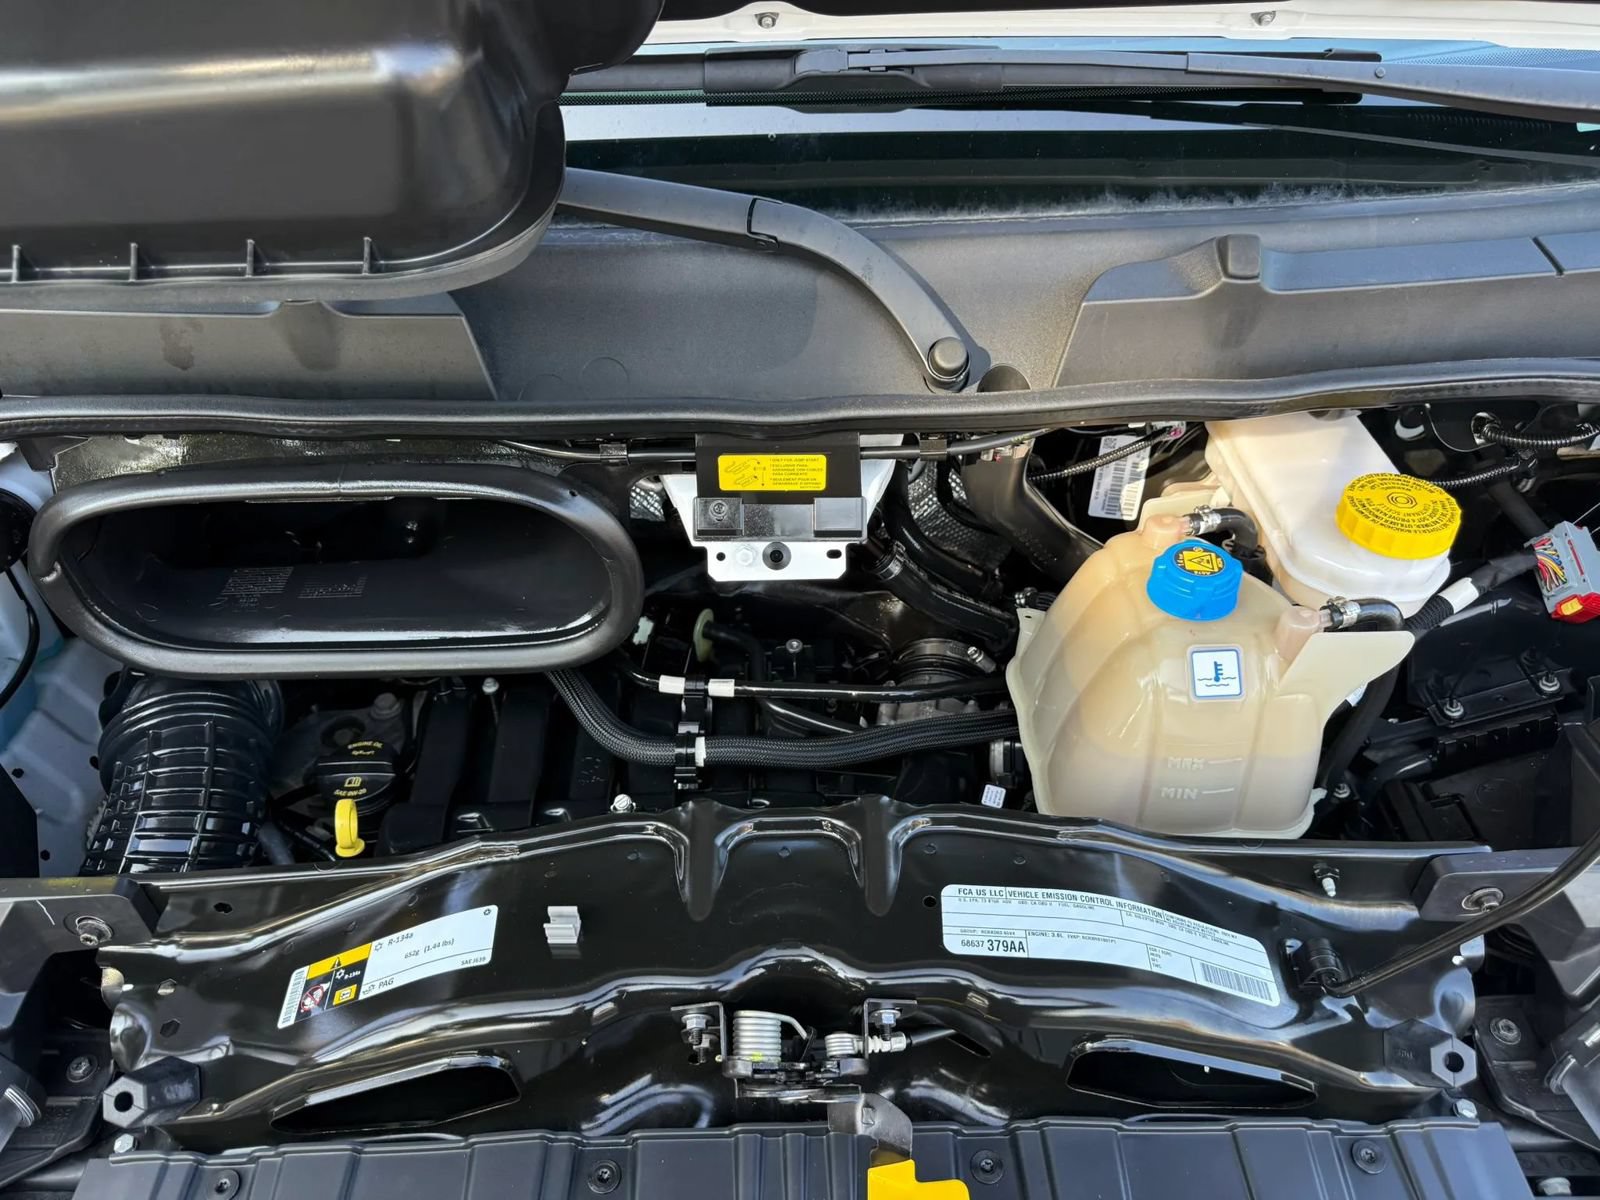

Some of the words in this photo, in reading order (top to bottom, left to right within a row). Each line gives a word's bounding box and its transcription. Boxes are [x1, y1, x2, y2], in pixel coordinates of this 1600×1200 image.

[1160, 787, 1199, 800] MIN
[957, 887, 973, 896] FCA
[976, 888, 987, 897] US
[989, 889, 1004, 898] LLC
[1007, 889, 1039, 899] VEHICLE
[1041, 891, 1078, 902] EMISSION
[1080, 894, 1113, 907] CONTROL
[1115, 900, 1163, 919] INFORMATION
[387, 932, 414, 947] R-134a
[960, 939, 985, 948] 68637
[987, 939, 1026, 954] 379AA
[404, 948, 420, 959] 652g
[423, 941, 441, 953] (1.44
[441, 937, 455, 949] lbs)
[460, 958, 473, 966] SAE
[378, 977, 395, 990] PAG
